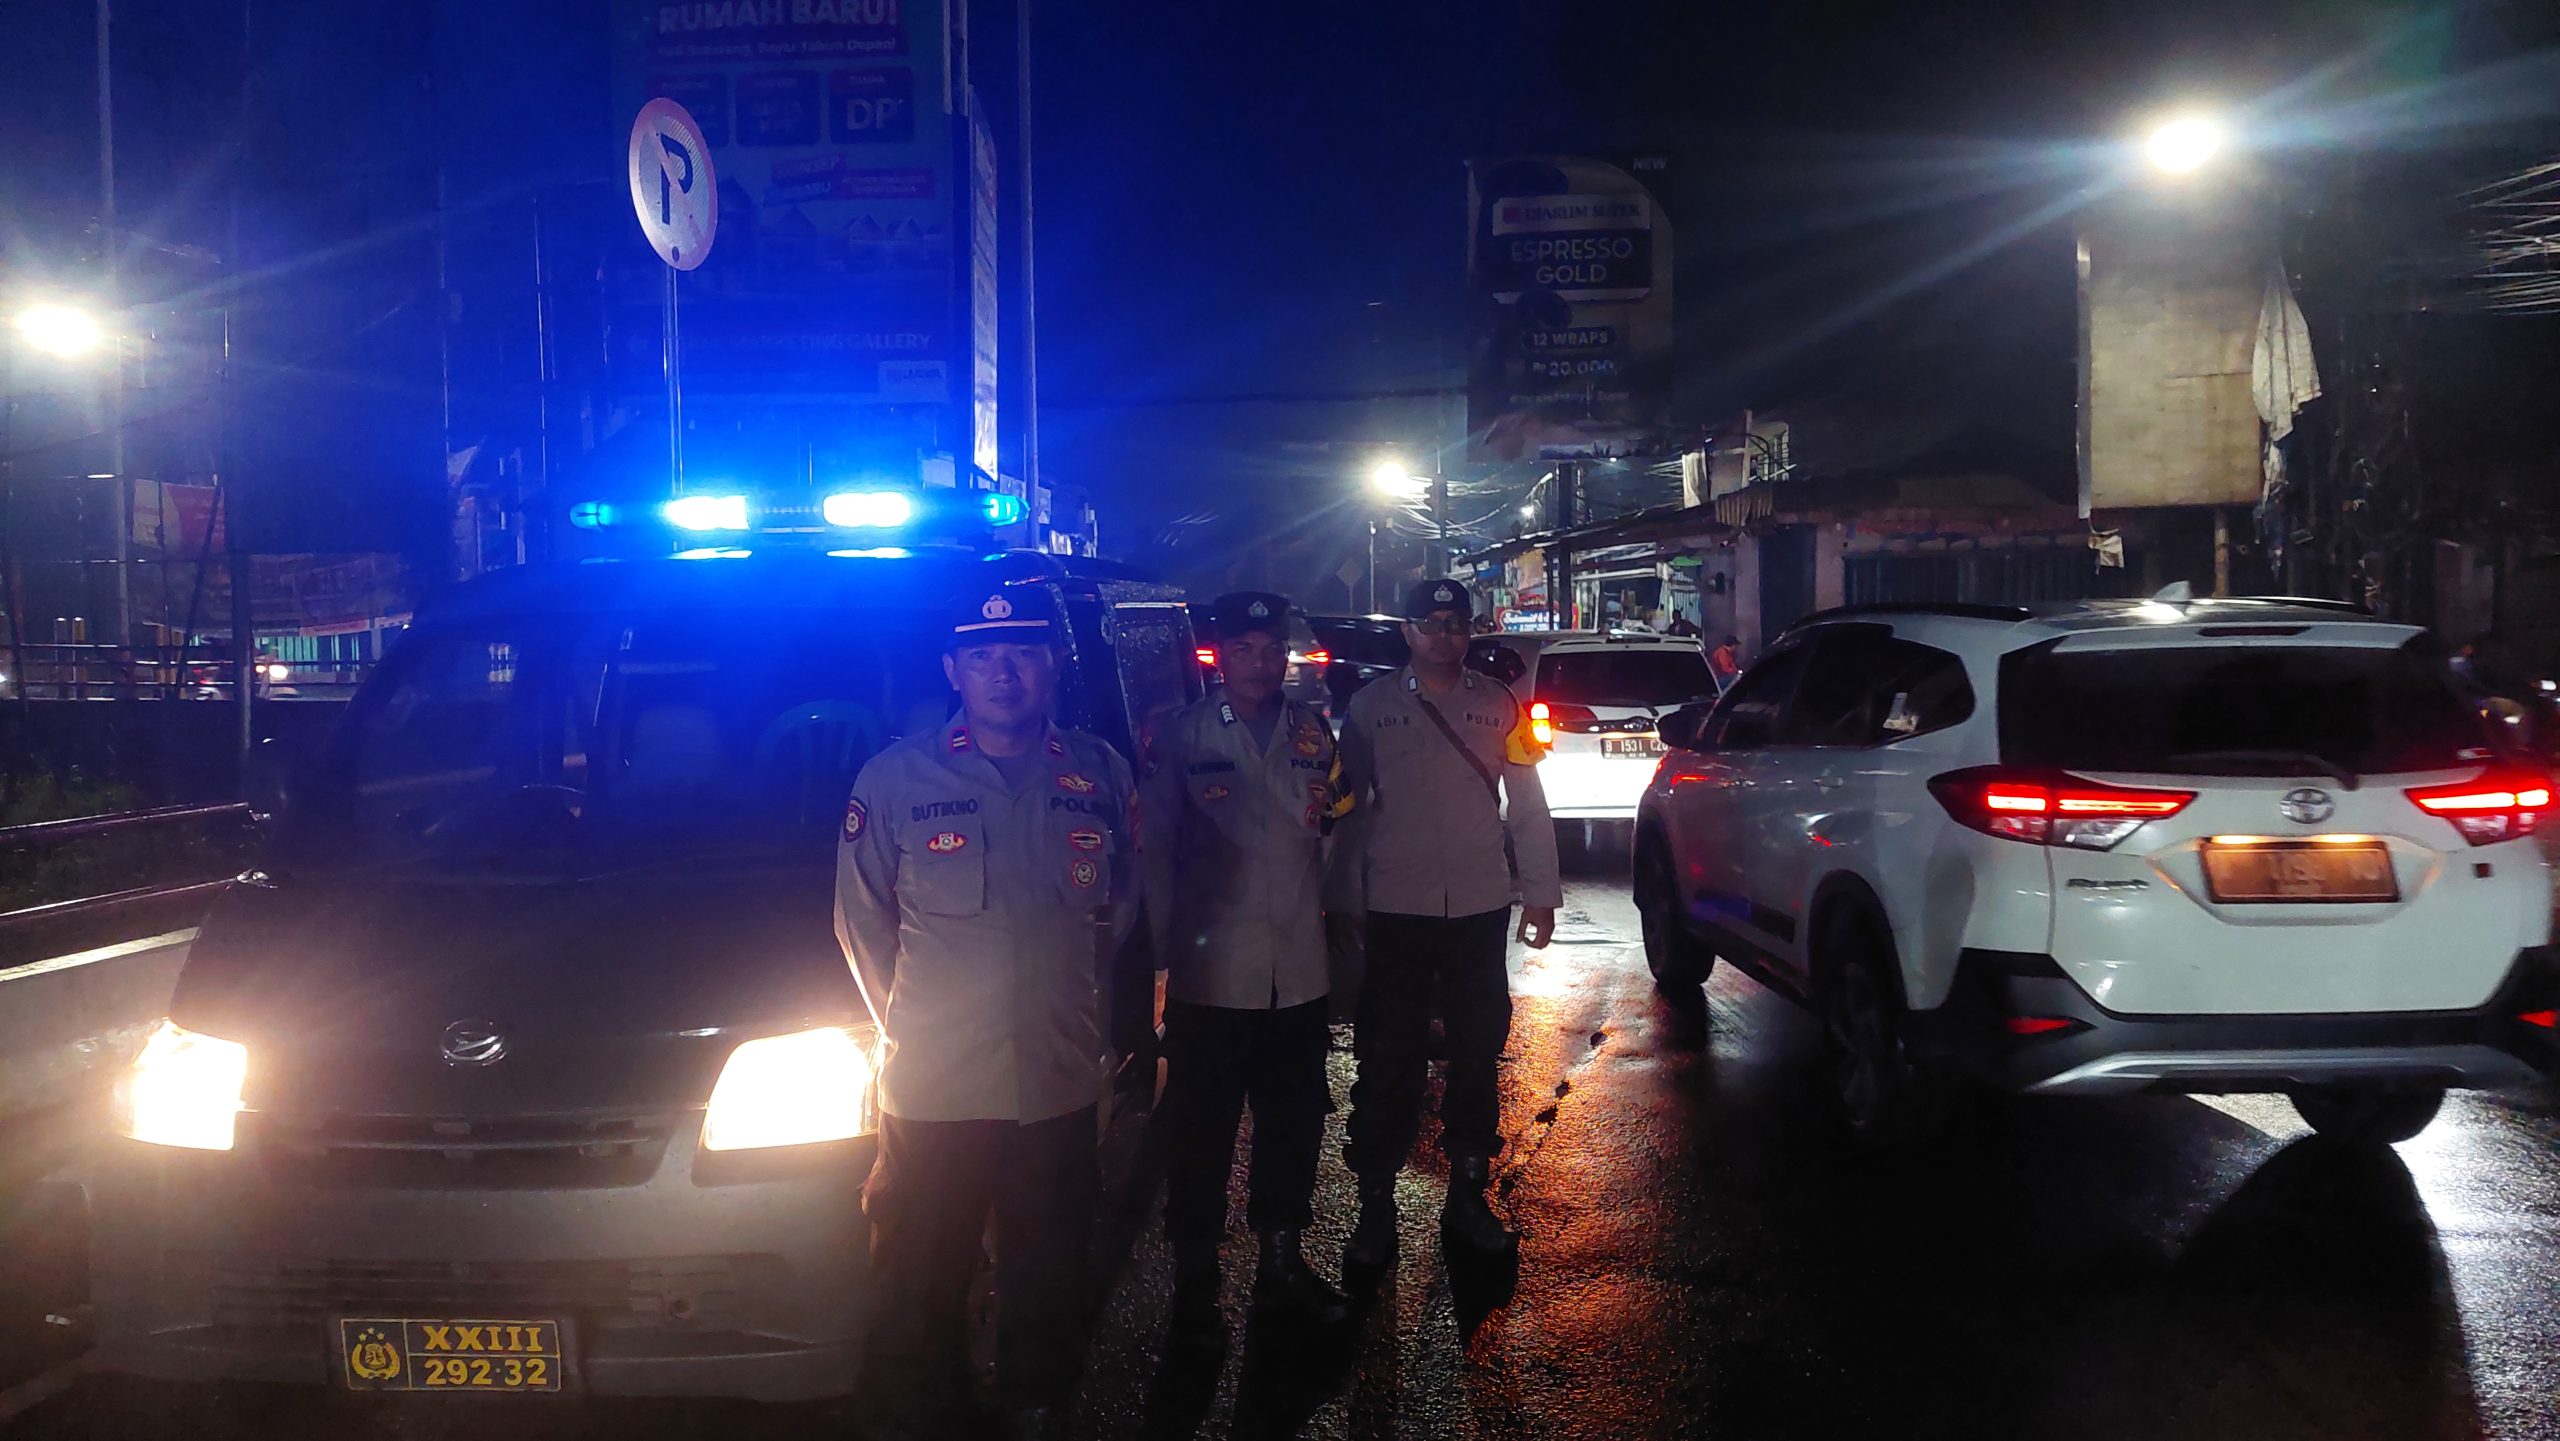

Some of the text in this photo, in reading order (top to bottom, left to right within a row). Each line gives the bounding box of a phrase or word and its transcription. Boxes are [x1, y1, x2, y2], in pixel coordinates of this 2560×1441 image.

[658, 0, 898, 34] RUMAH BARU!
[1632, 156, 1669, 171] NEW
[1511, 237, 1633, 263] ESPRESSO
[1535, 263, 1607, 285] GOLD
[848, 333, 932, 350] GALLERY
[1533, 331, 1609, 346] 12 WRAPS
[1605, 740, 1613, 752] B
[1620, 739, 1643, 753] 1531
[422, 1325, 543, 1351] XXIII
